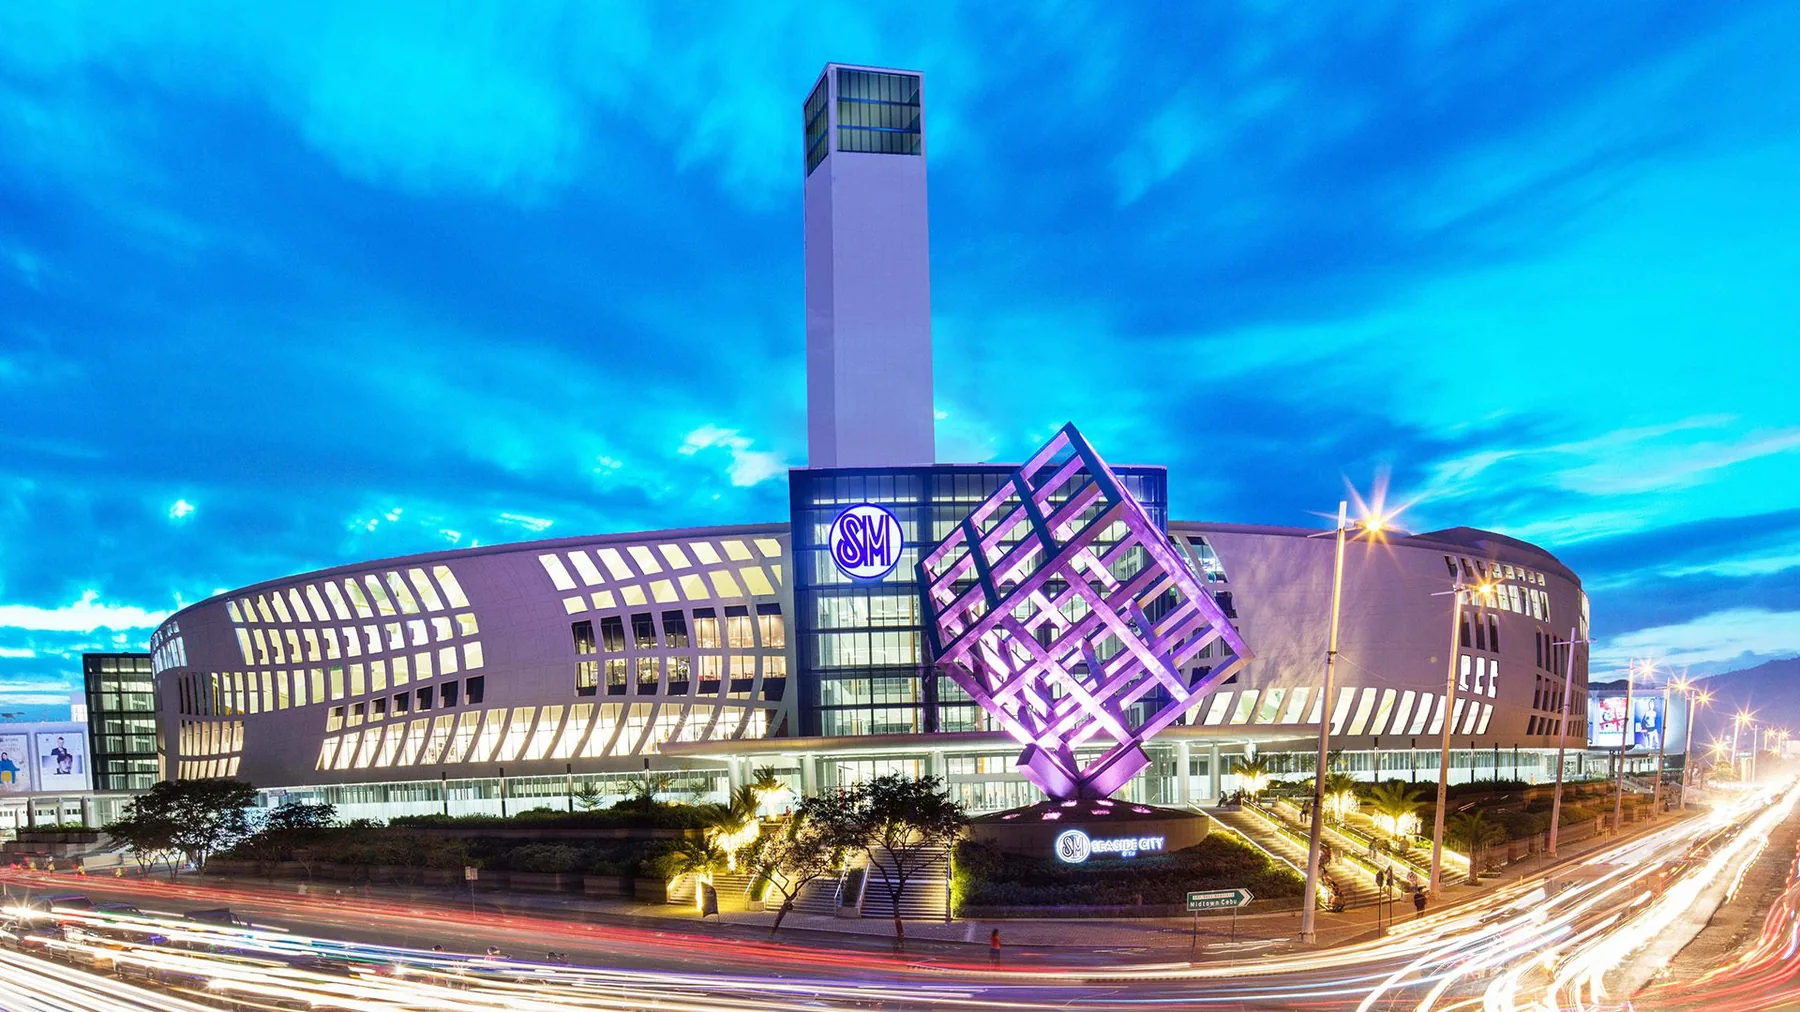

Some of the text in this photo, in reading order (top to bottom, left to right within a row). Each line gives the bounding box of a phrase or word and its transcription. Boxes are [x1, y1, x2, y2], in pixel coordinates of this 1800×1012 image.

[835, 511, 893, 570] SM
[1060, 834, 1164, 859] SM SEASIDE CITY
[1190, 898, 1238, 908] Midtown Cebu
